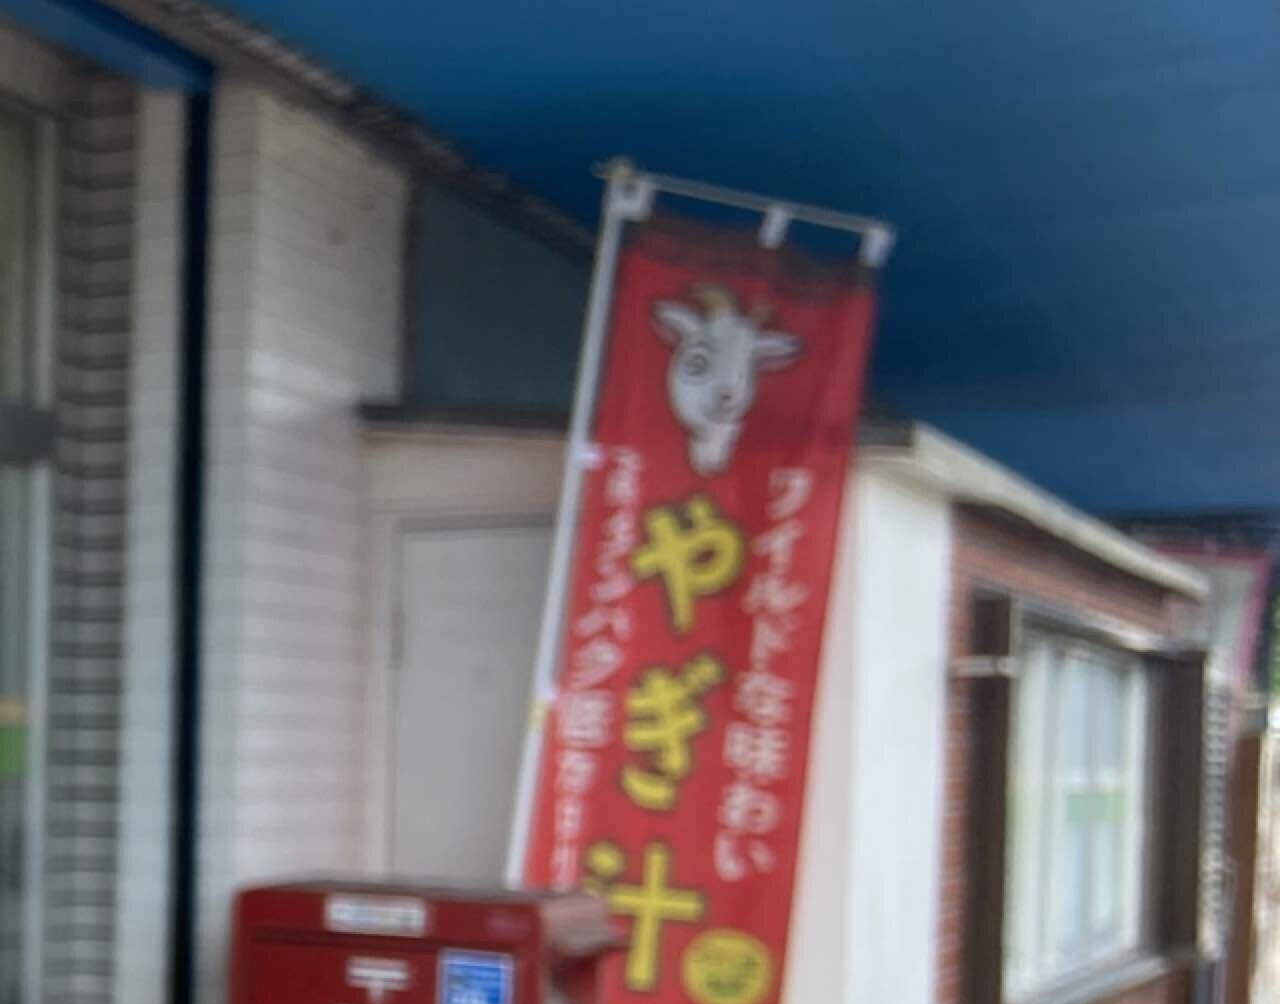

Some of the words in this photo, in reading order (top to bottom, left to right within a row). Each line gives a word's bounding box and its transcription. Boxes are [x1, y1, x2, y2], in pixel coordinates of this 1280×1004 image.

[584, 500, 742, 990] やぎ汁
[714, 469, 813, 882] ワイルドな味わい
